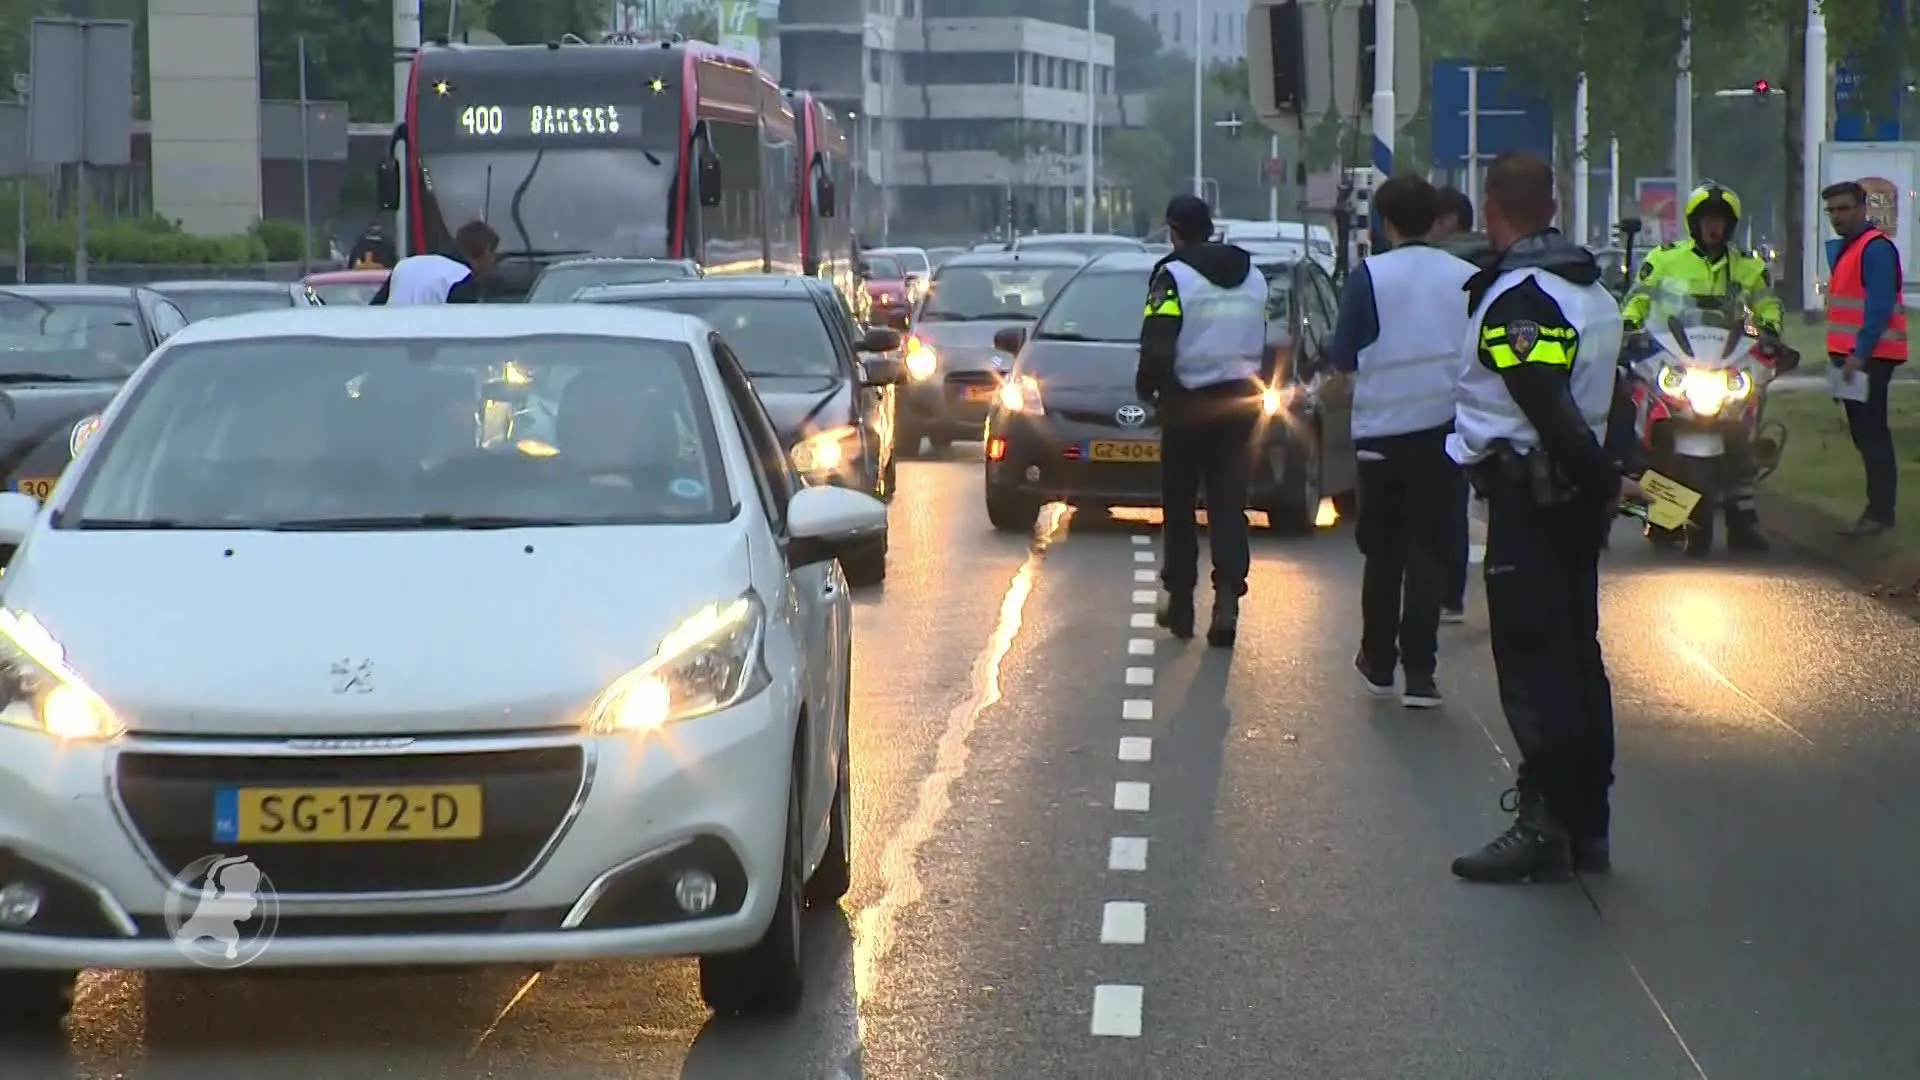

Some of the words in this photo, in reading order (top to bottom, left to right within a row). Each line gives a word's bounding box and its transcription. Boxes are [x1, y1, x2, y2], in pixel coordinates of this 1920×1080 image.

[461, 105, 502, 134] 400
[1095, 443, 1160, 459] GZ-404-
[260, 793, 459, 833] SG-172-D
